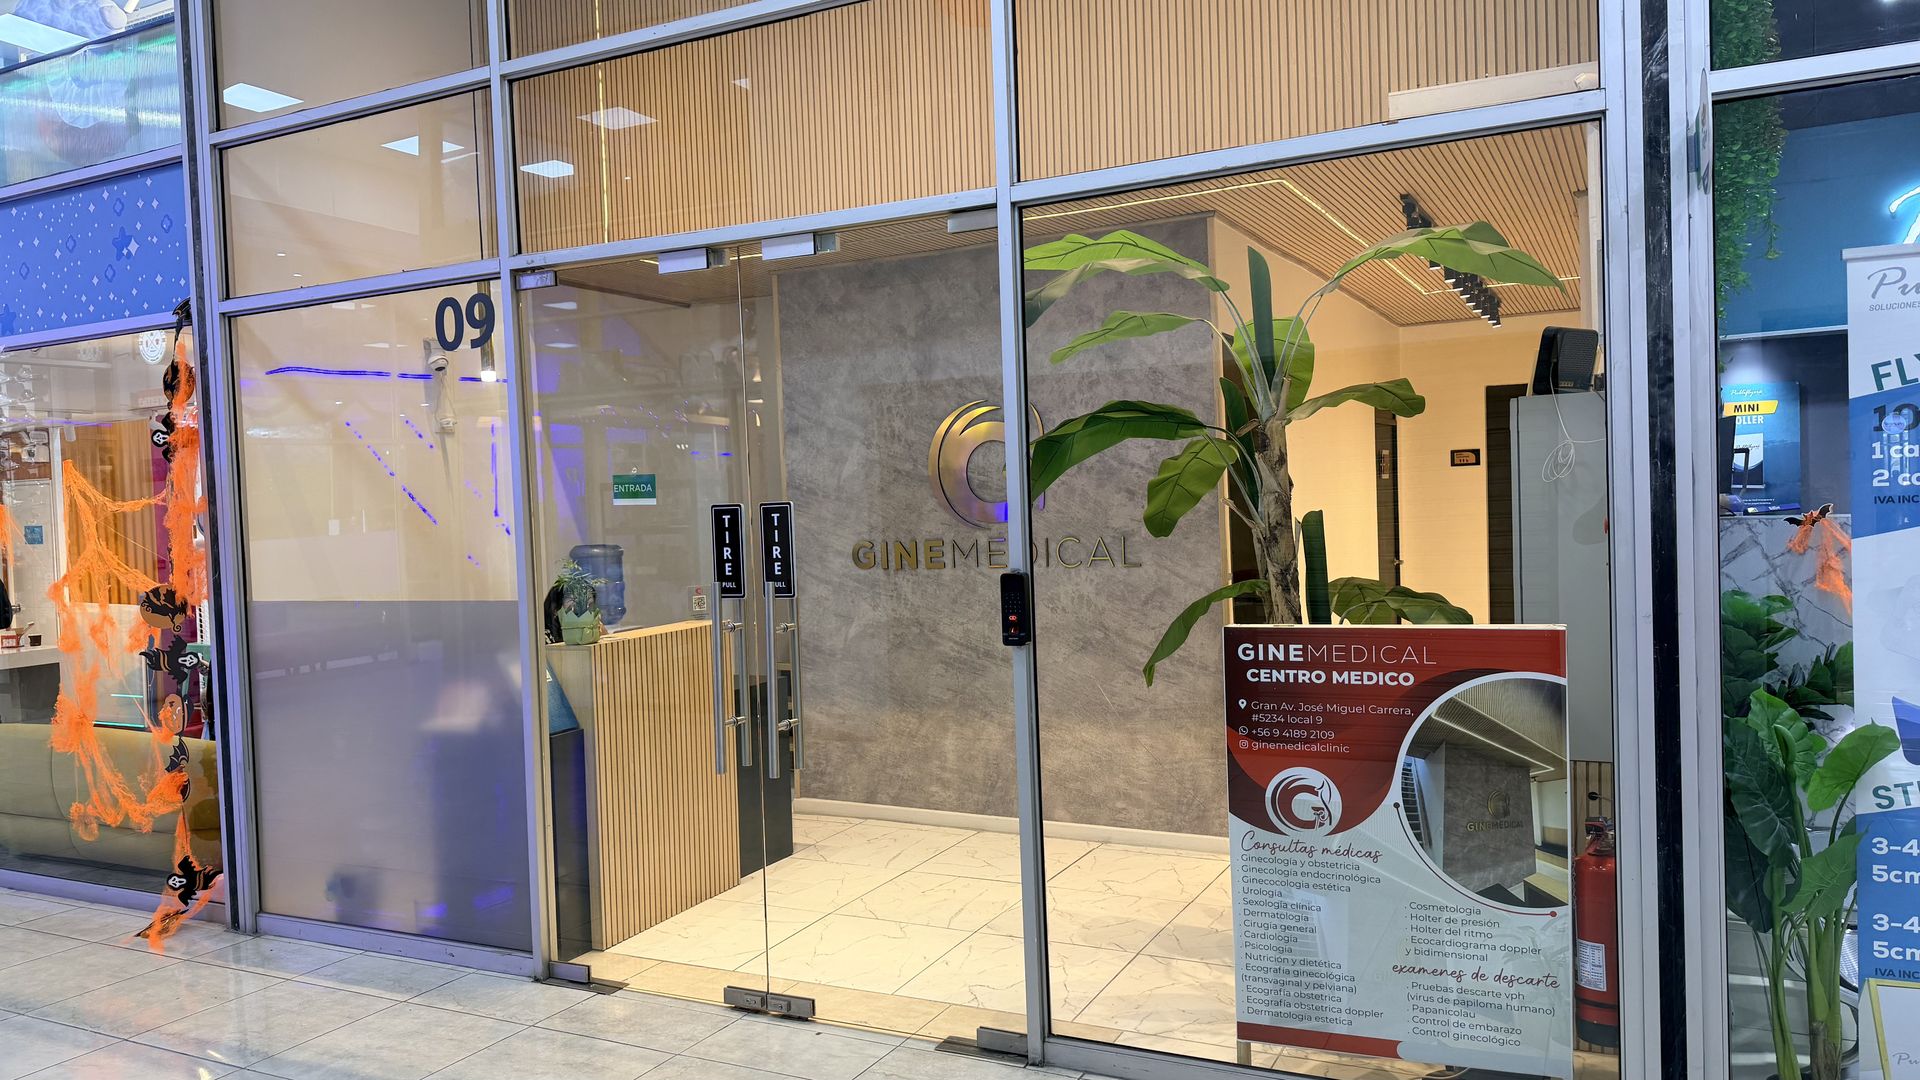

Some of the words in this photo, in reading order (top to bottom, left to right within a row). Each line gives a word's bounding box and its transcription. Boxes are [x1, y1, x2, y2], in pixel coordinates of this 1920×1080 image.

[435, 292, 496, 351] 09
[1871, 353, 1920, 392] FL
[1734, 403, 1759, 413] MINI
[1735, 415, 1764, 425] OLLER
[1871, 441, 1884, 459] 1
[1872, 469, 1890, 487] 2
[613, 483, 652, 493] ENTRADA
[1874, 496, 1895, 505] IVA
[1898, 495, 1920, 504] INC
[722, 515, 732, 576] TIRE
[771, 513, 782, 575] TIRE
[852, 535, 1142, 570] GINEMEICAL
[1237, 643, 1437, 665] GINEMEDICAL
[1246, 668, 1326, 684] CENTRO
[1332, 671, 1415, 687] MEDICO
[1251, 701, 1277, 711] Gran
[1281, 702, 1296, 711] Av.
[1299, 702, 1324, 712] José
[1326, 704, 1365, 715] Miguel
[1368, 705, 1414, 717] Carrera,
[1251, 714, 1285, 723] #5234
[1287, 714, 1313, 725] local
[1315, 716, 1323, 725] 9
[1251, 727, 1270, 737] +56
[1272, 728, 1280, 737] 9
[1282, 729, 1307, 739] 4189
[1310, 730, 1335, 740] 2109
[1251, 740, 1350, 754] ginemedicalclinic
[1872, 781, 1920, 810] ST
[1241, 830, 1318, 858] Consultas
[1321, 842, 1383, 863] médicas
[1299, 859, 1306, 868] y
[1307, 859, 1360, 871] obstetricia
[1300, 870, 1381, 884] endocrinológica
[1312, 882, 1351, 893] estética
[1280, 925, 1317, 934] general
[1410, 913, 1442, 923] Holter
[1444, 915, 1458, 925] de
[1461, 918, 1500, 929] presión
[1410, 924, 1442, 935] Holter
[1445, 927, 1461, 937] del
[1464, 929, 1493, 939] ritmo
[1405, 948, 1411, 956] y
[1414, 947, 1488, 962] bidimensional
[1410, 936, 1497, 951] Ecocardiograma
[1500, 943, 1542, 956] doppler
[1245, 952, 1289, 964] Nutrición
[1291, 958, 1297, 966] y
[1299, 958, 1342, 970] dietética
[1292, 969, 1355, 982] ginecológica
[1392, 964, 1467, 983] examenes
[1471, 966, 1489, 983] de
[1494, 968, 1561, 988] descarte
[1874, 968, 1896, 977] IVA
[1898, 970, 1920, 979] INC
[1241, 973, 1303, 988] (transvaginal
[1304, 981, 1311, 990] y
[1313, 981, 1357, 994] pelviana)
[1411, 981, 1454, 994] Pruebas
[1456, 986, 1502, 999] descarte
[1504, 991, 1525, 1002] vph
[1345, 1006, 1384, 1019] doppler
[1407, 992, 1434, 1003] (virus
[1437, 995, 1450, 1005] de
[1453, 998, 1503, 1010] papiloma
[1505, 1003, 1555, 1017] humano)
[1412, 1004, 1476, 1019] Papanicolau
[1412, 1015, 1450, 1027] Control
[1452, 1020, 1466, 1029] de
[1469, 1022, 1522, 1035] embarazo
[1412, 1026, 1450, 1039] Control
[1452, 1032, 1521, 1047] ginecológico
